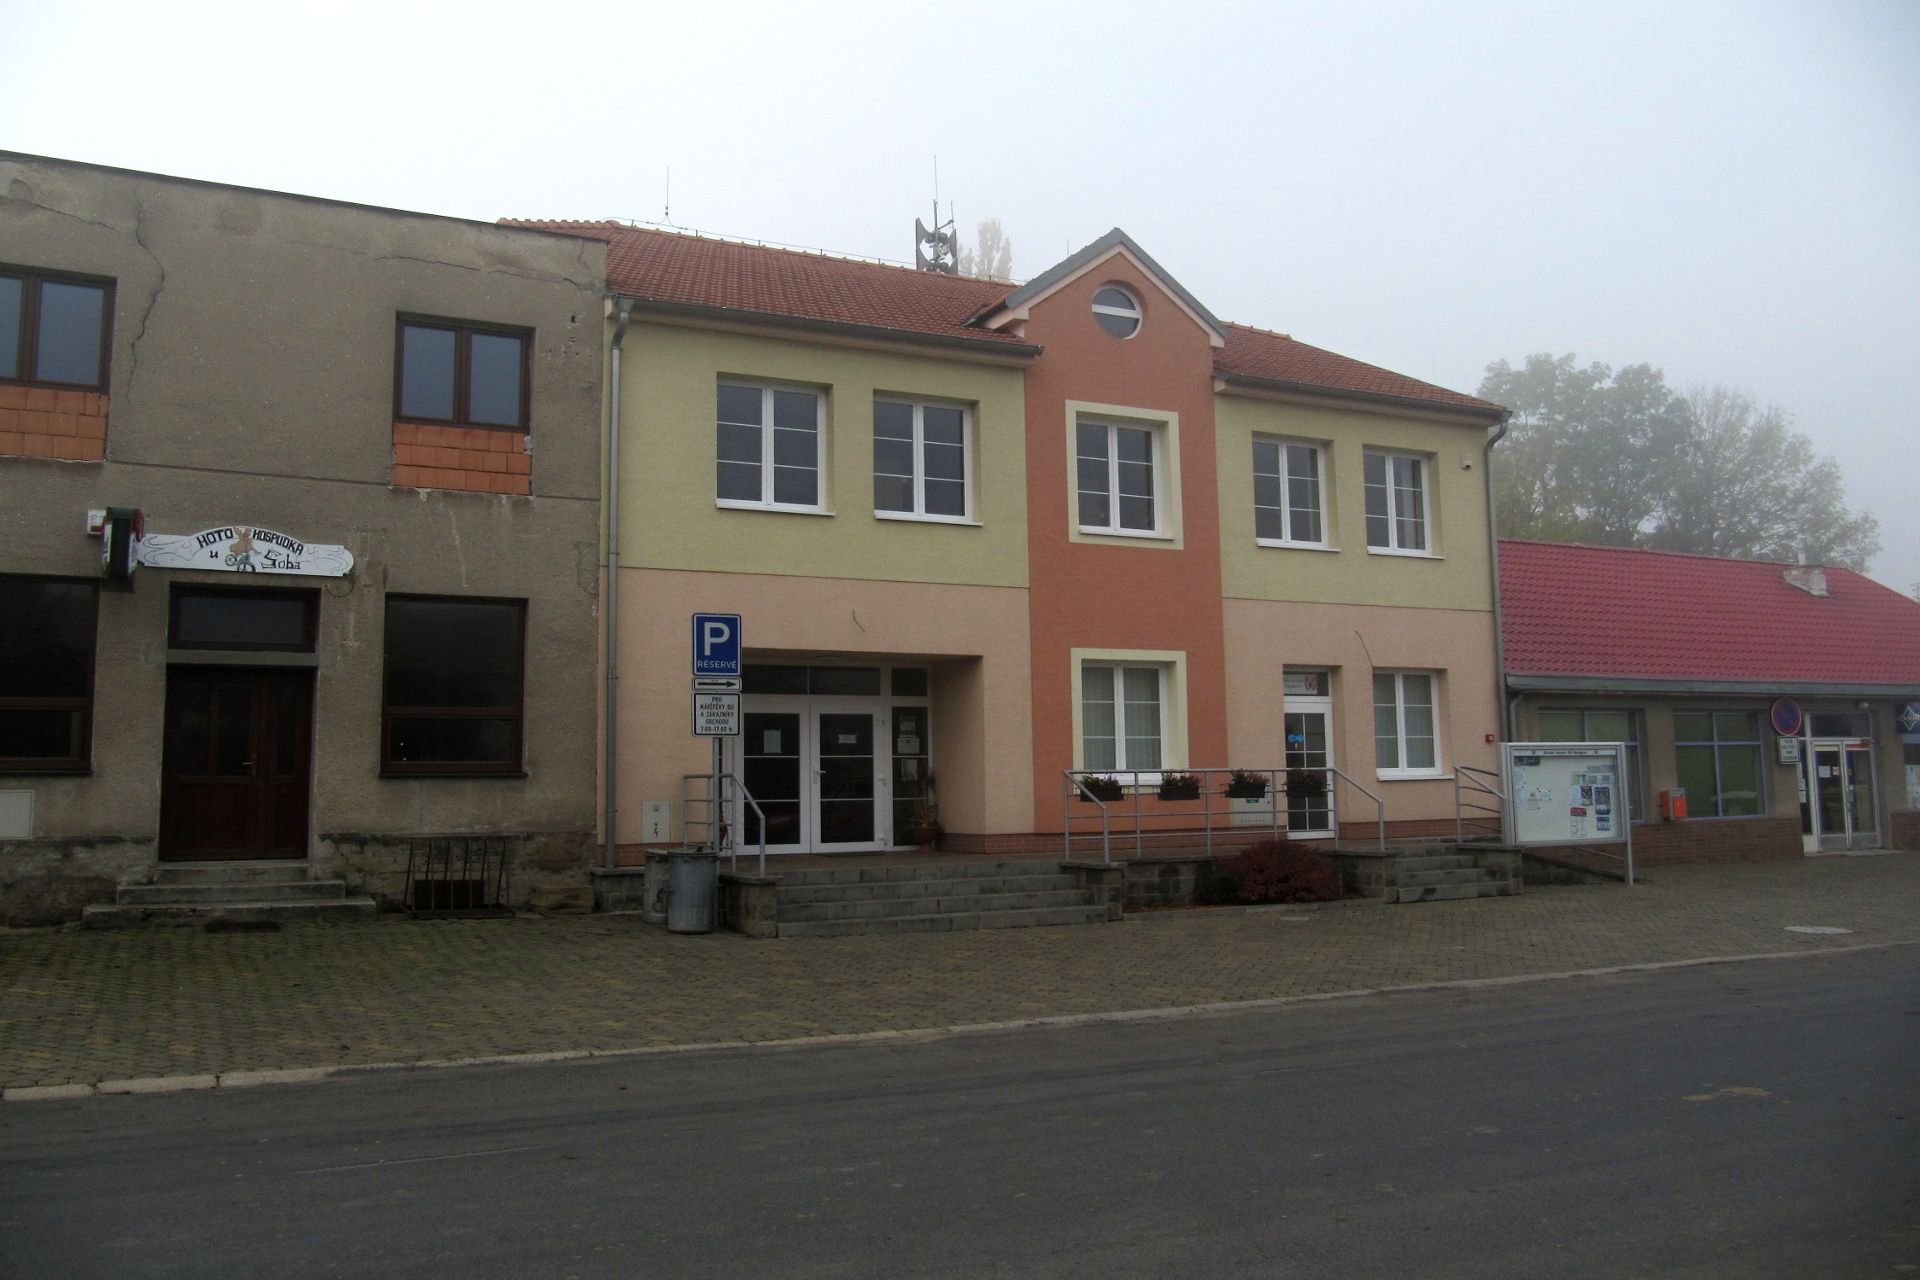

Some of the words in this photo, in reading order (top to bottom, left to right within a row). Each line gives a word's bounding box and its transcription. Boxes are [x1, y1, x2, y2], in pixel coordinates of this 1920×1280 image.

[252, 529, 304, 556] HOSPUDKA
[704, 622, 730, 656] P
[697, 659, 737, 669] RÉSERVÉ
[706, 710, 734, 718] ZÁKAZNÍKY
